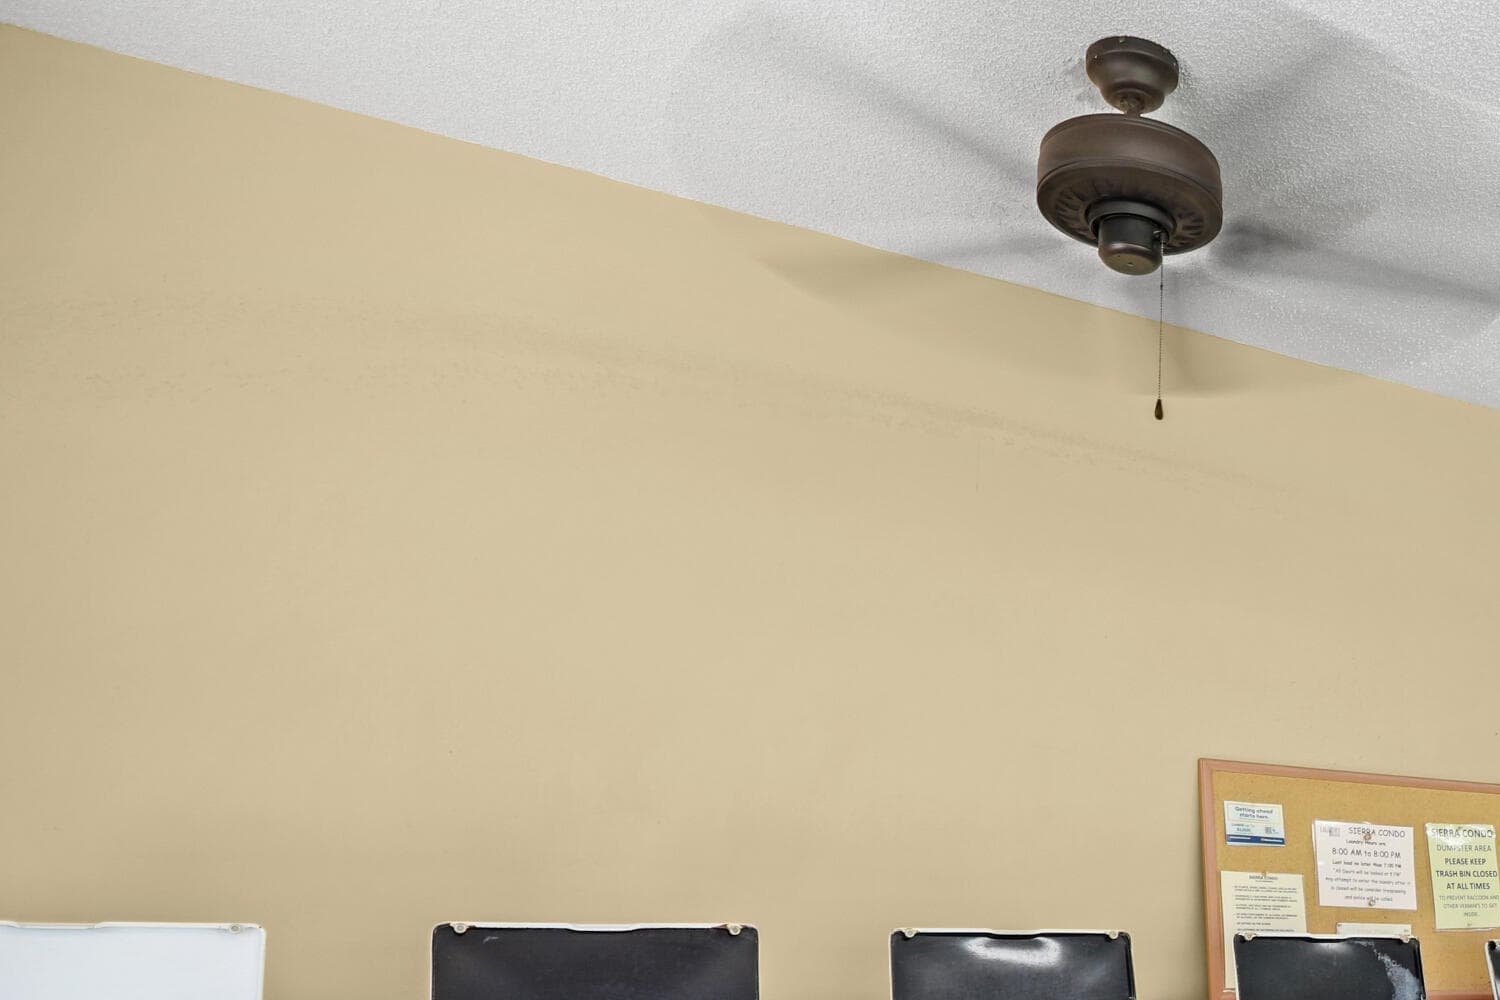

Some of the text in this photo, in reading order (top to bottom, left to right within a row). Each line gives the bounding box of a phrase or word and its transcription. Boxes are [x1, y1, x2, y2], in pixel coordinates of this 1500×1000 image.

[1235, 806, 1255, 814] Getting
[1348, 827, 1376, 835] SIERRA
[1378, 830, 1406, 838] CONDO
[1431, 828, 1494, 838] SIERRA CONDO
[1436, 844, 1473, 852] DUMPSTER
[1472, 870, 1498, 878] CLOSED
